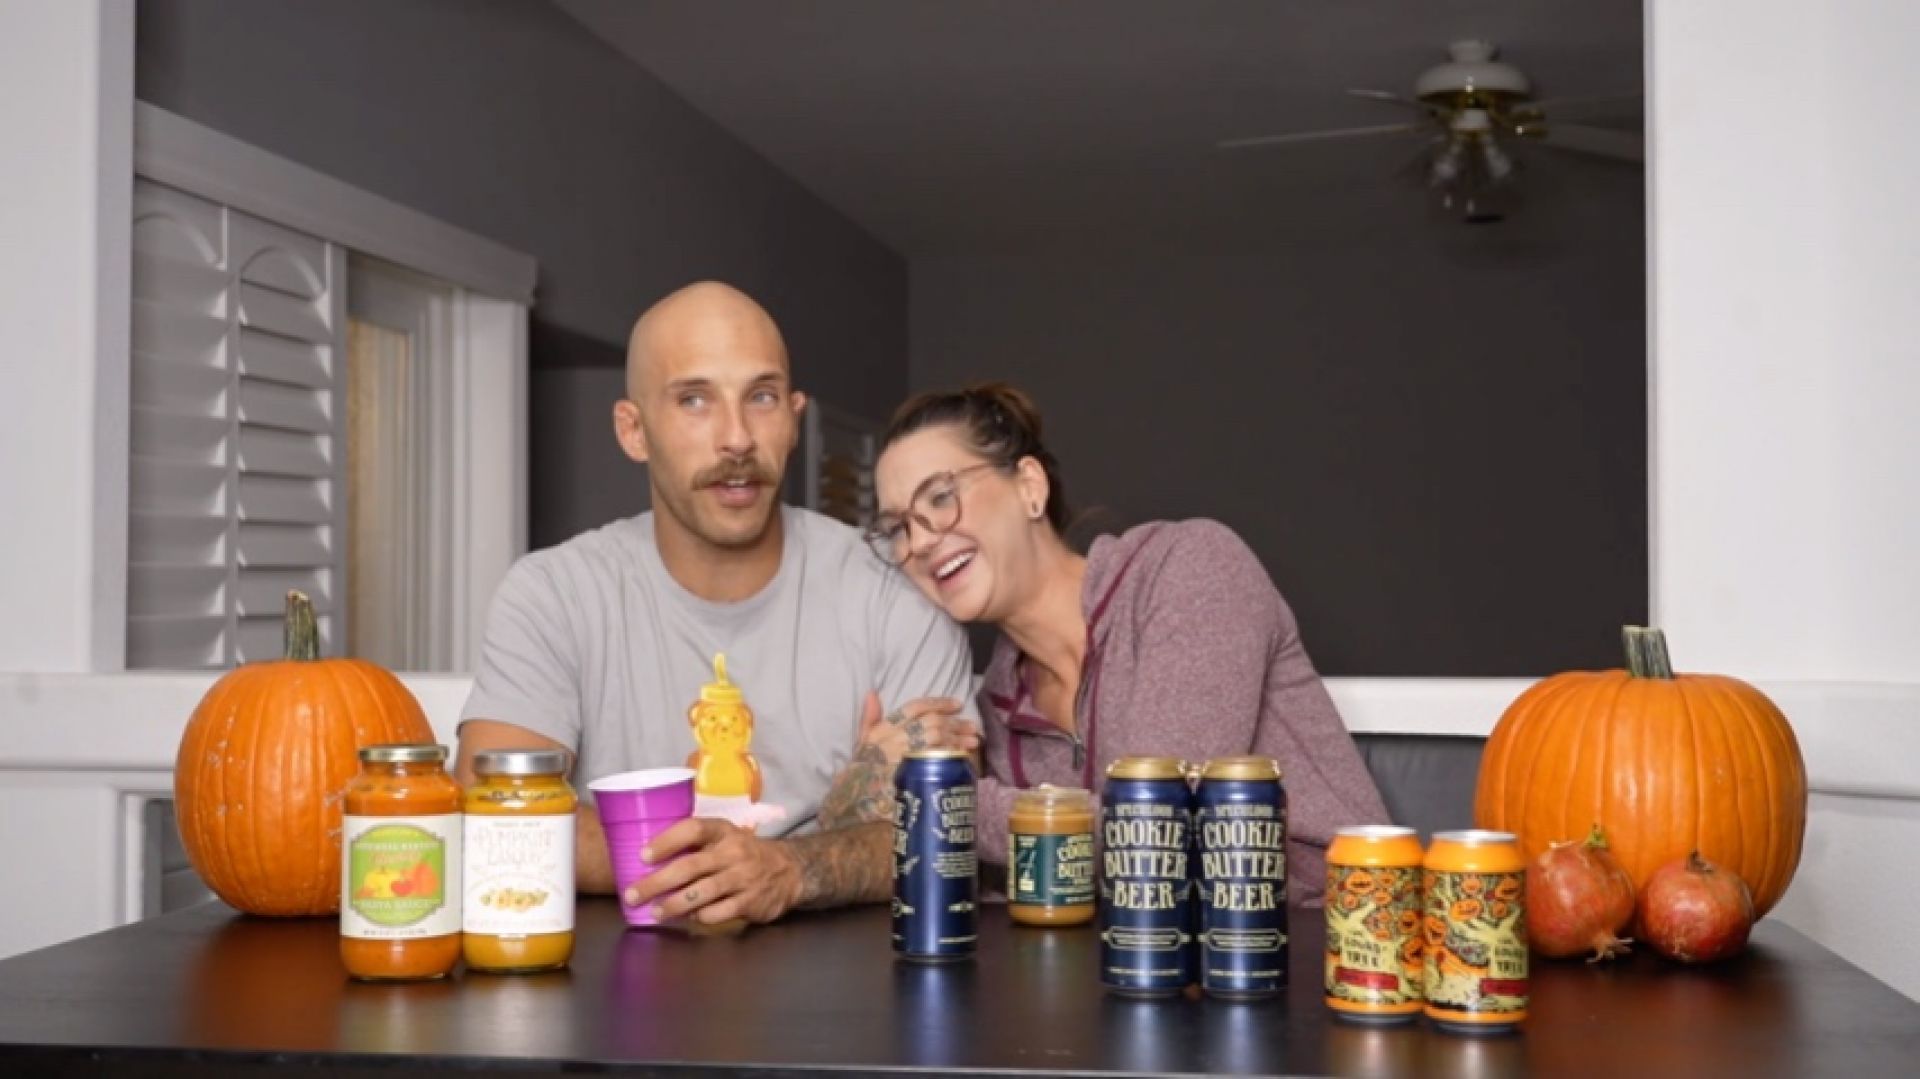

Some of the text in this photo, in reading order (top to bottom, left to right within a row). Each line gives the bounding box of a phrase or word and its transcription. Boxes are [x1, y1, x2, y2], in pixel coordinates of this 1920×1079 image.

[1105, 820, 1186, 848] COOKIE
[1203, 821, 1284, 849] COOKIE
[1103, 851, 1188, 880] BUTTER
[1202, 851, 1287, 880] BUTTER
[1113, 880, 1176, 909] BEER
[1213, 880, 1276, 911] BEER
